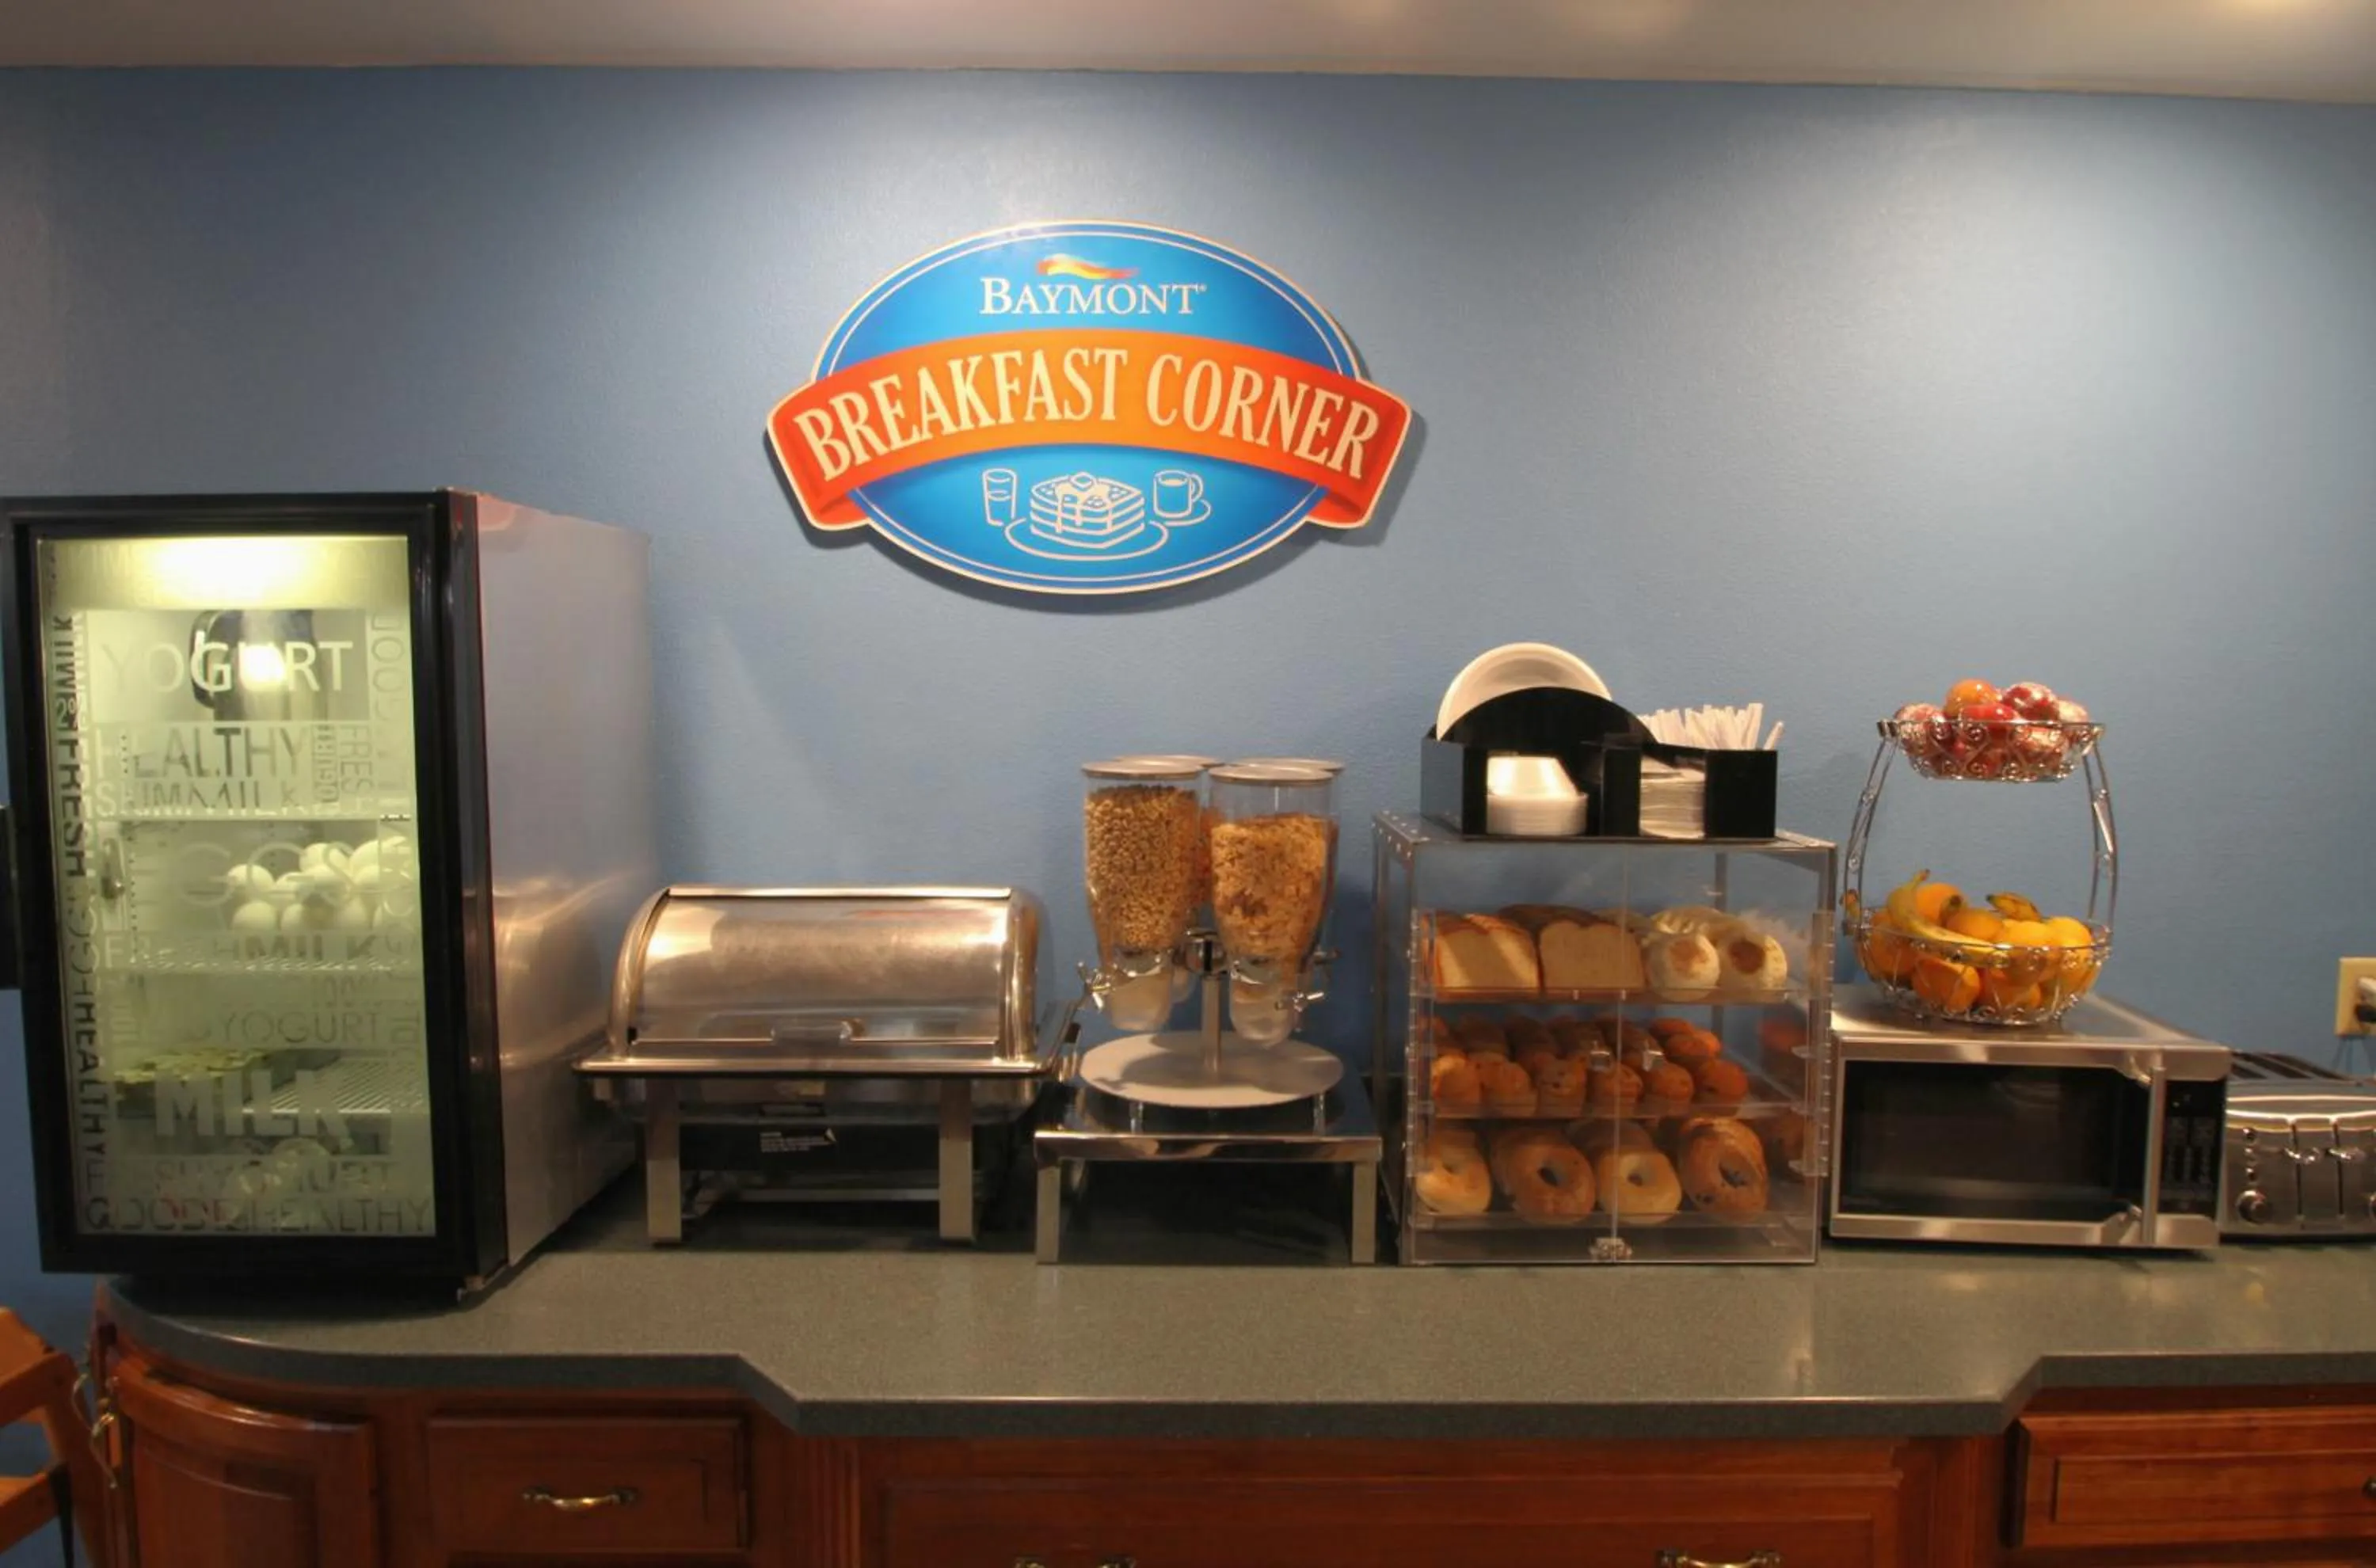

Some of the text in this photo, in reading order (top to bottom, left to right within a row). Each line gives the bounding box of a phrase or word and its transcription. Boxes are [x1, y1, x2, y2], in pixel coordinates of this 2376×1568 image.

[979, 277, 1198, 315] BAYMONT
[793, 346, 1381, 482] BREAKFAST CORNER
[98, 640, 353, 694] YOGURT
[94, 726, 308, 780] HEALTHY
[57, 737, 97, 879] FRESH
[219, 1008, 382, 1045] YOGURT
[74, 1002, 109, 1156] HEALTHY
[156, 1067, 354, 1138] MILK
